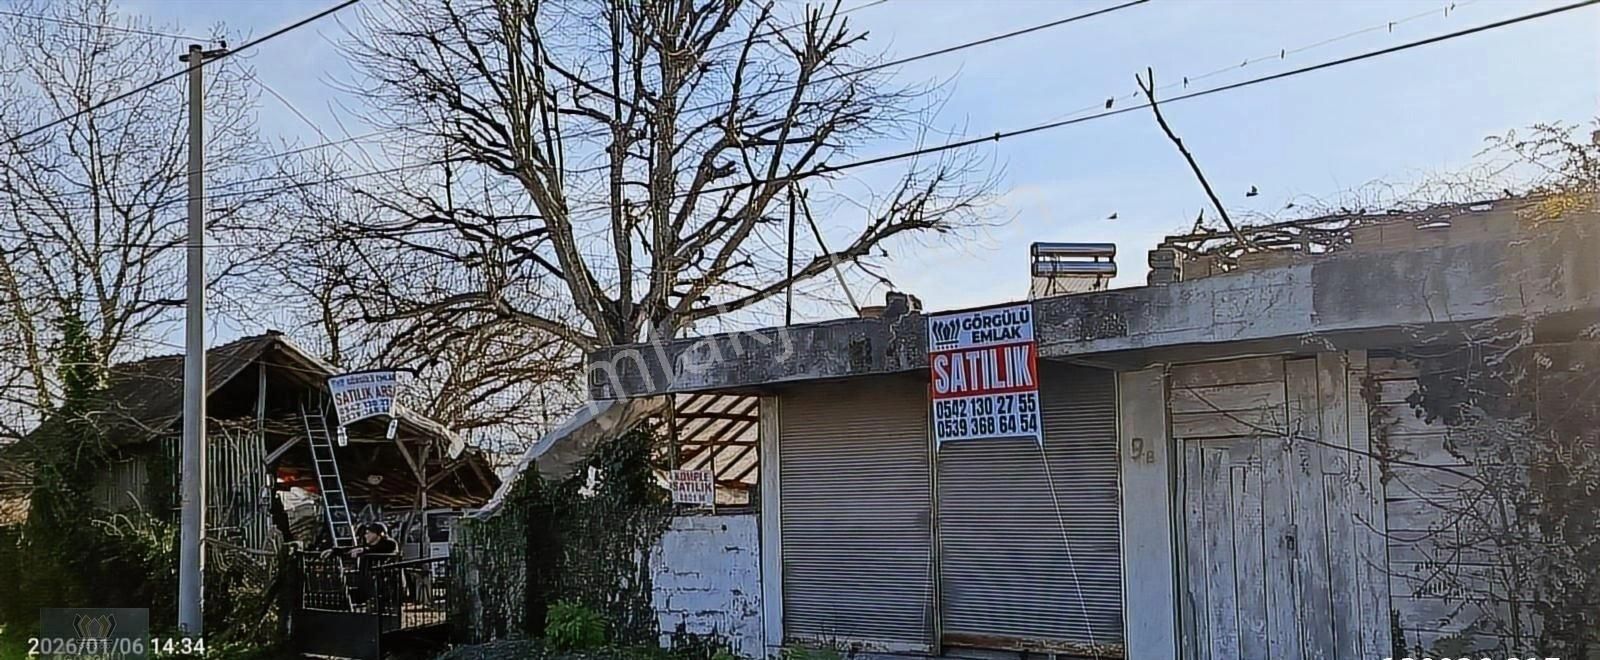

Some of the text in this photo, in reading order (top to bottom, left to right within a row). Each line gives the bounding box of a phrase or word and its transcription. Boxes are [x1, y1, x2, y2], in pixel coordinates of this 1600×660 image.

[962, 307, 1029, 331] GÖRGÜLÜ
[972, 326, 1021, 344] EMLAK
[934, 345, 1033, 394] SATILIK
[335, 387, 373, 406] SATILIK
[936, 393, 1036, 419] 0542 130 27 55
[938, 413, 1038, 438] 0539 368 64 54
[672, 482, 712, 495] SATILIK
